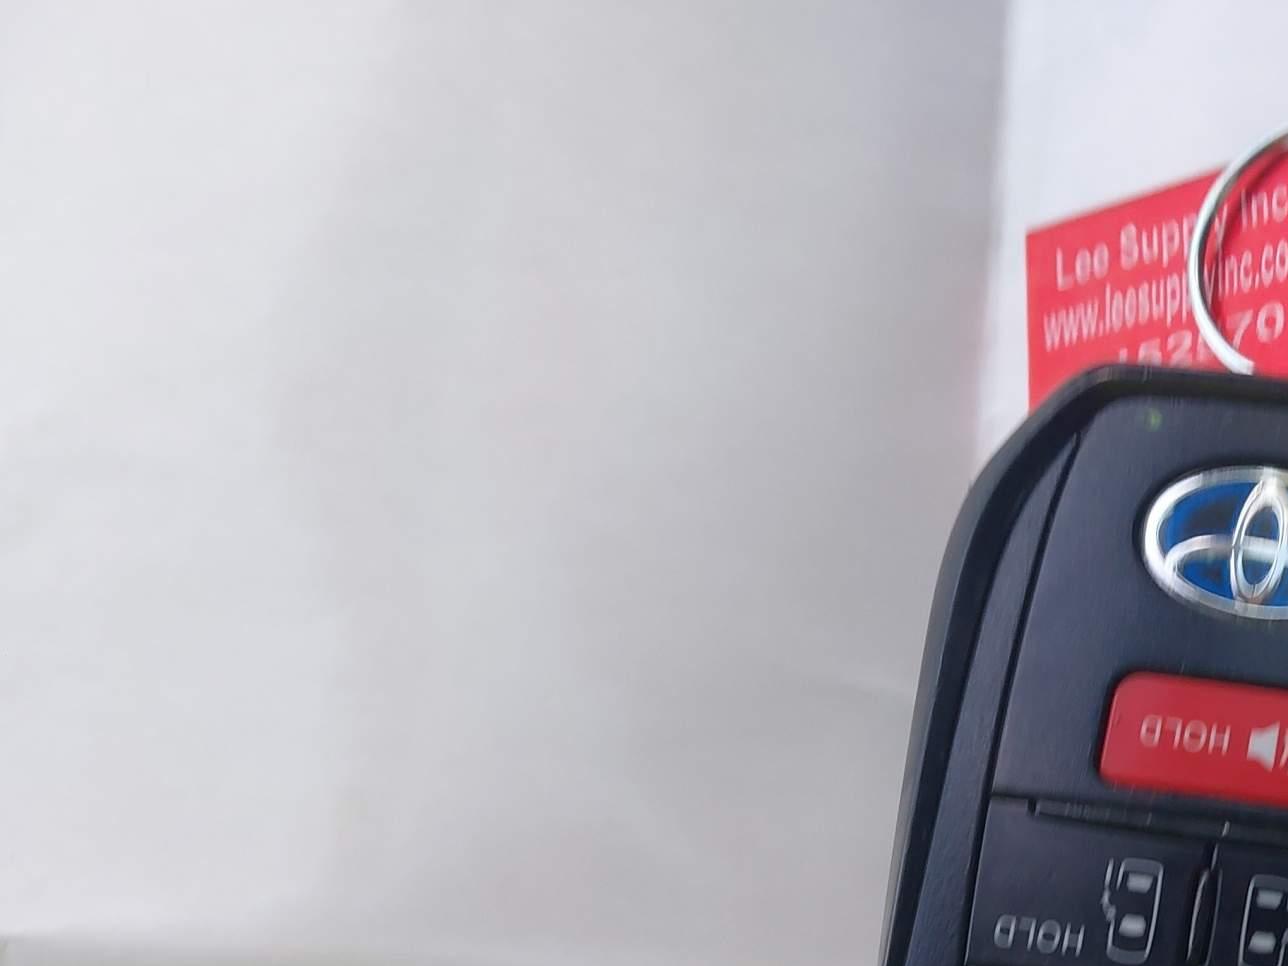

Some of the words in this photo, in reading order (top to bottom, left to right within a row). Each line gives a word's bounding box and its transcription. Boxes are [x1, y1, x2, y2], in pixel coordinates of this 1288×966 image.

[1056, 242, 1109, 291] Lee
[1120, 203, 1228, 270] Suppy
[1118, 301, 1286, 366] 5270
[1140, 714, 1231, 756] HOLD
[994, 914, 1085, 957] HOLD
